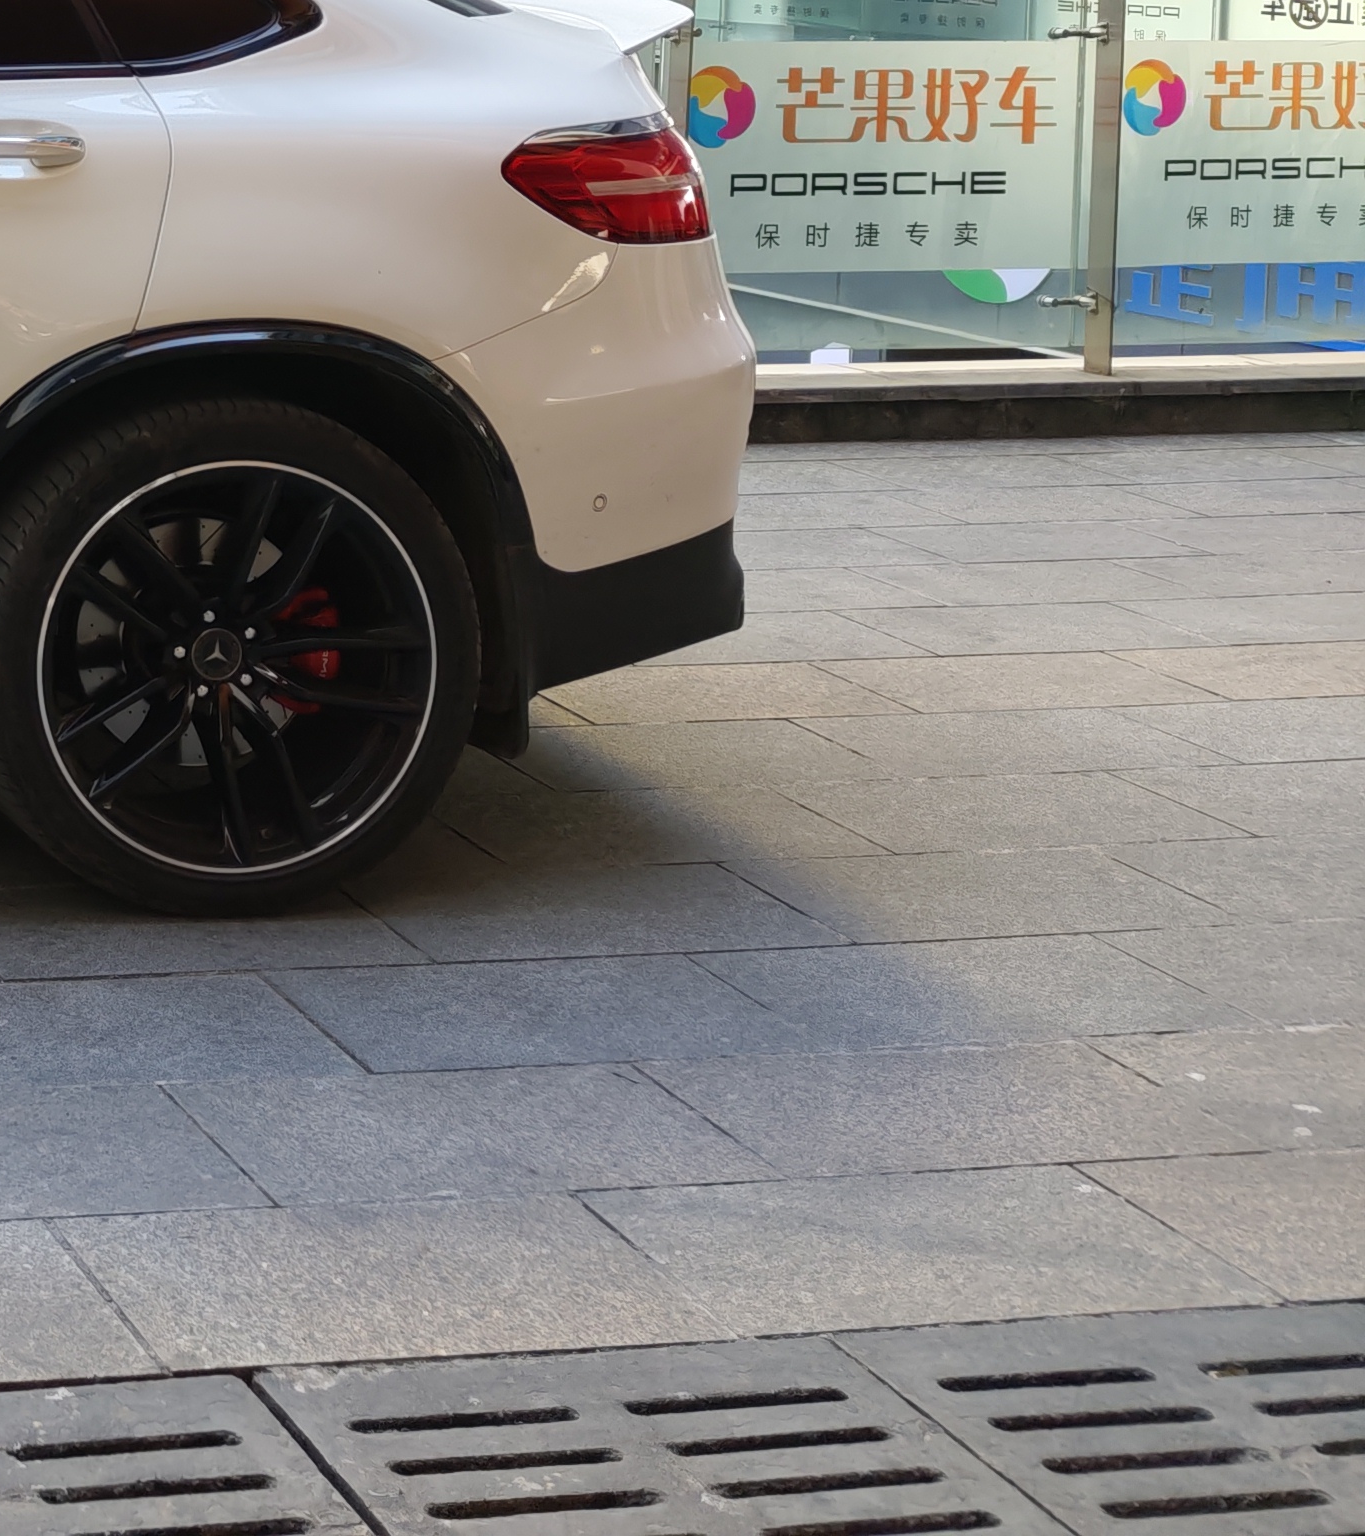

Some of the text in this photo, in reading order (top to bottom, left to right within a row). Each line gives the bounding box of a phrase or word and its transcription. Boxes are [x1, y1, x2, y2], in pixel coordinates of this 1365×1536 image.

[775, 65, 1058, 145] 芒果好车
[730, 170, 1007, 197] PORSCHE
[754, 220, 980, 250] 保时捷专卖
